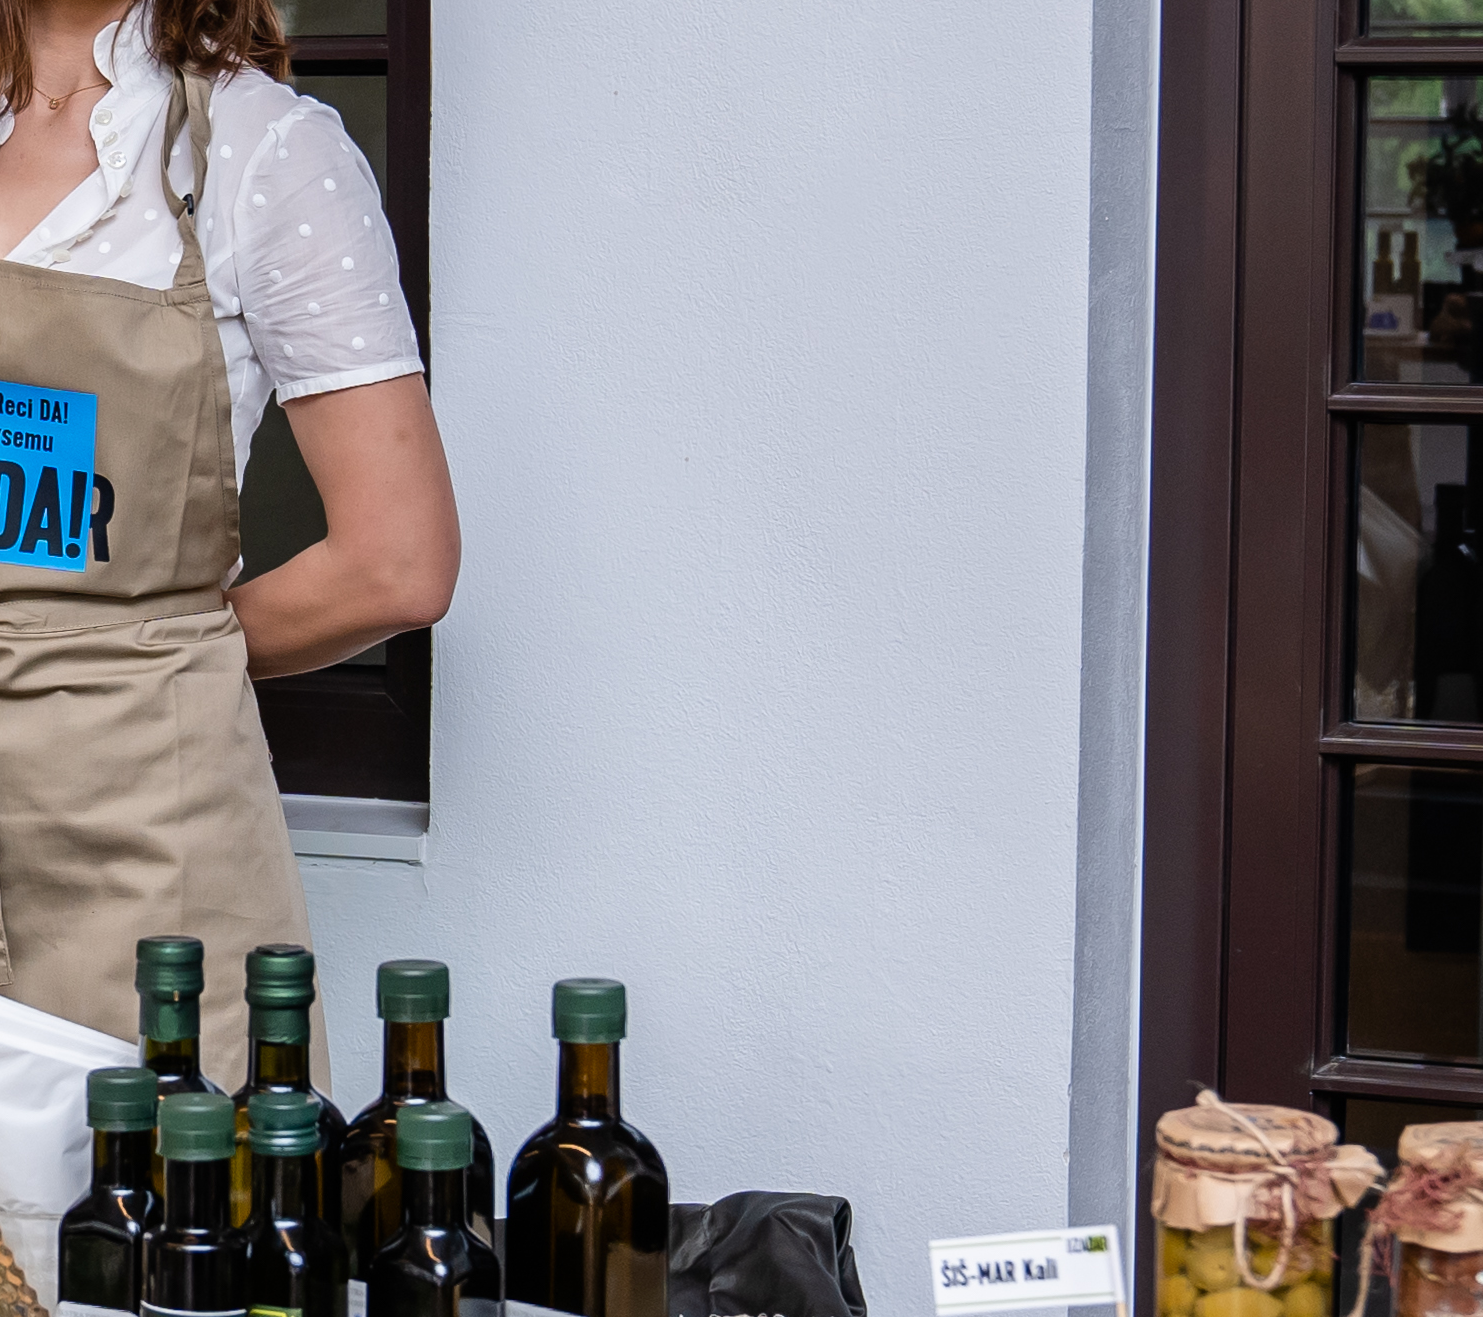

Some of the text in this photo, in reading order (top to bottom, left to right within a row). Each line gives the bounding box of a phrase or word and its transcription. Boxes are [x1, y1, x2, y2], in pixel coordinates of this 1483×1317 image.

[39, 398, 69, 424] DA!
[941, 1256, 1059, 1287] ŠIŠ-MAR Kali
